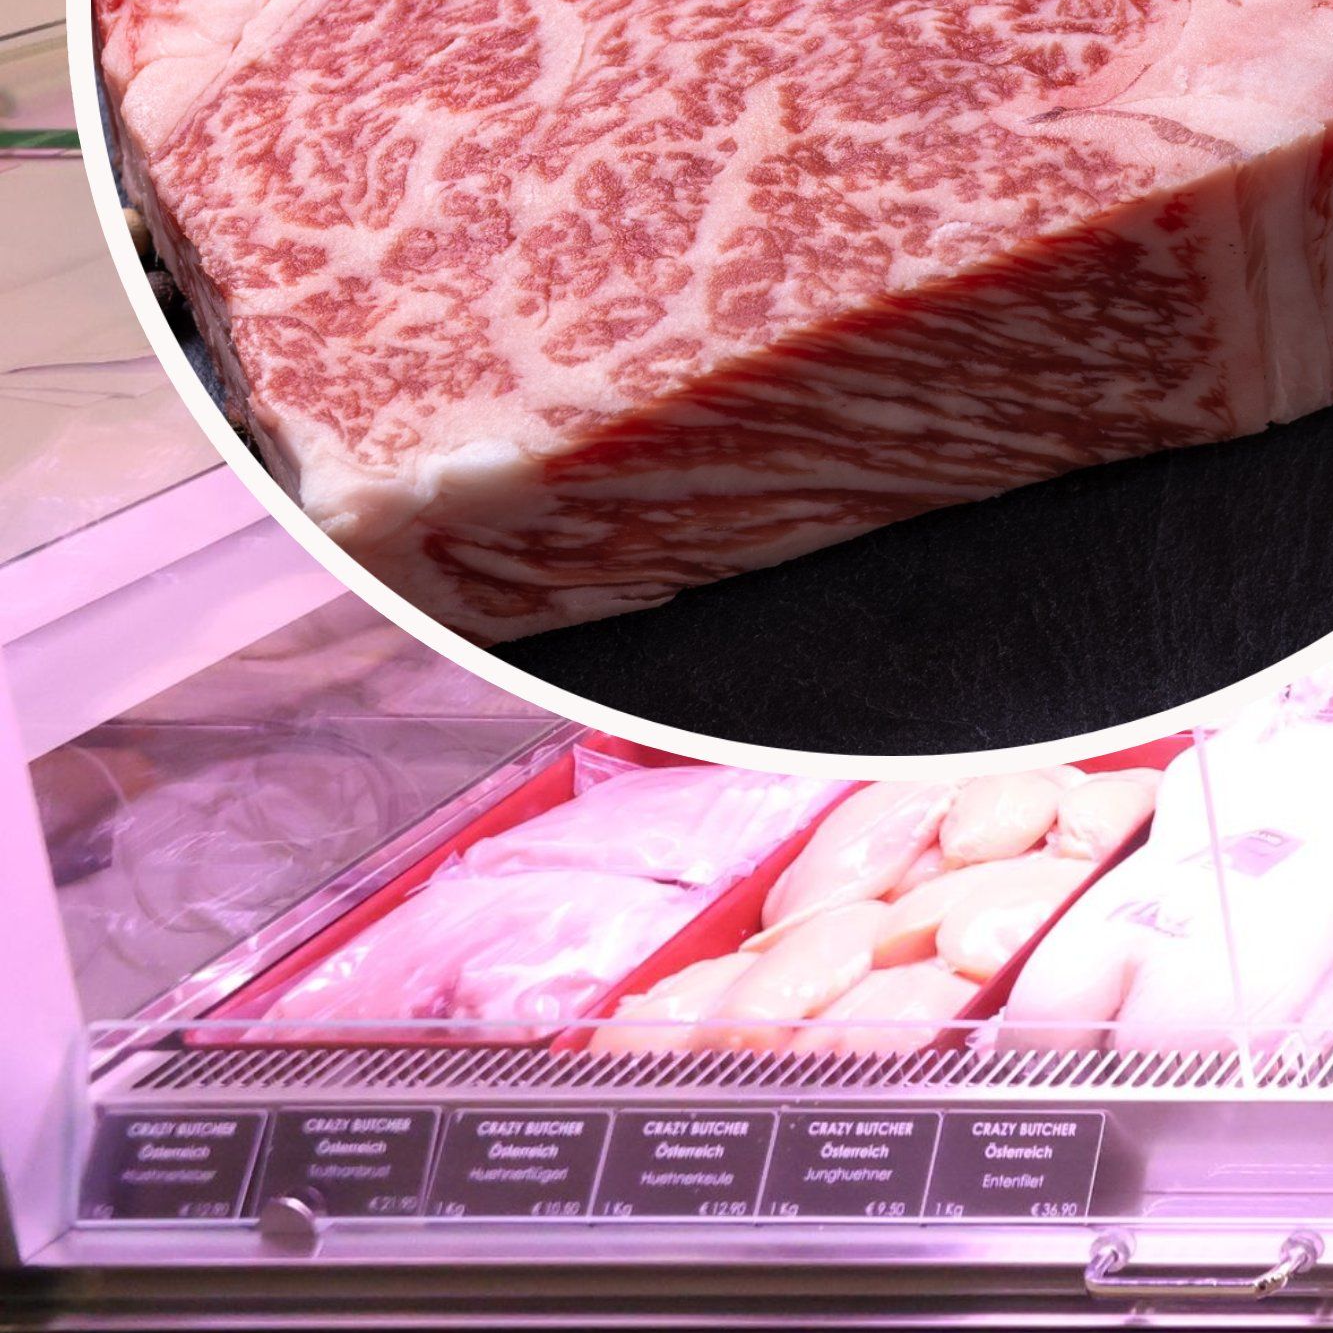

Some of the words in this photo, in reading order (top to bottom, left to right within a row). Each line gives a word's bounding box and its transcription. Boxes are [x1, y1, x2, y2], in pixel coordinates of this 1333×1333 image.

[303, 1118, 350, 1134] CRAZY
[351, 1118, 411, 1133] BUTCHER
[477, 1121, 523, 1137] CRAZY
[525, 1121, 584, 1136] BUTCHER
[643, 1121, 689, 1136] CRAZY
[691, 1122, 749, 1136] BUTCHER
[808, 1122, 854, 1136] CRAZY
[856, 1122, 913, 1136] BUTCHER
[972, 1122, 1017, 1136] CRAZY
[1020, 1123, 1077, 1137] BUTCHER
[315, 1138, 387, 1156] Österreich
[488, 1142, 559, 1159] Österreich
[654, 1141, 724, 1158] Österreich
[821, 1142, 889, 1158] Österreich
[985, 1142, 1052, 1159] Österreich
[804, 1168, 892, 1184] Junghuehner
[982, 1174, 1044, 1188] Entenfilet
[613, 1202, 632, 1216] Kg
[699, 1202, 709, 1215] €
[712, 1201, 746, 1216] 12.90
[780, 1202, 799, 1217] Kg
[865, 1202, 875, 1216] €
[878, 1202, 905, 1216] 9.50
[936, 1203, 941, 1215] 1
[945, 1203, 964, 1217] Kg
[1031, 1203, 1040, 1216] €
[1041, 1203, 1077, 1216] 36.90
